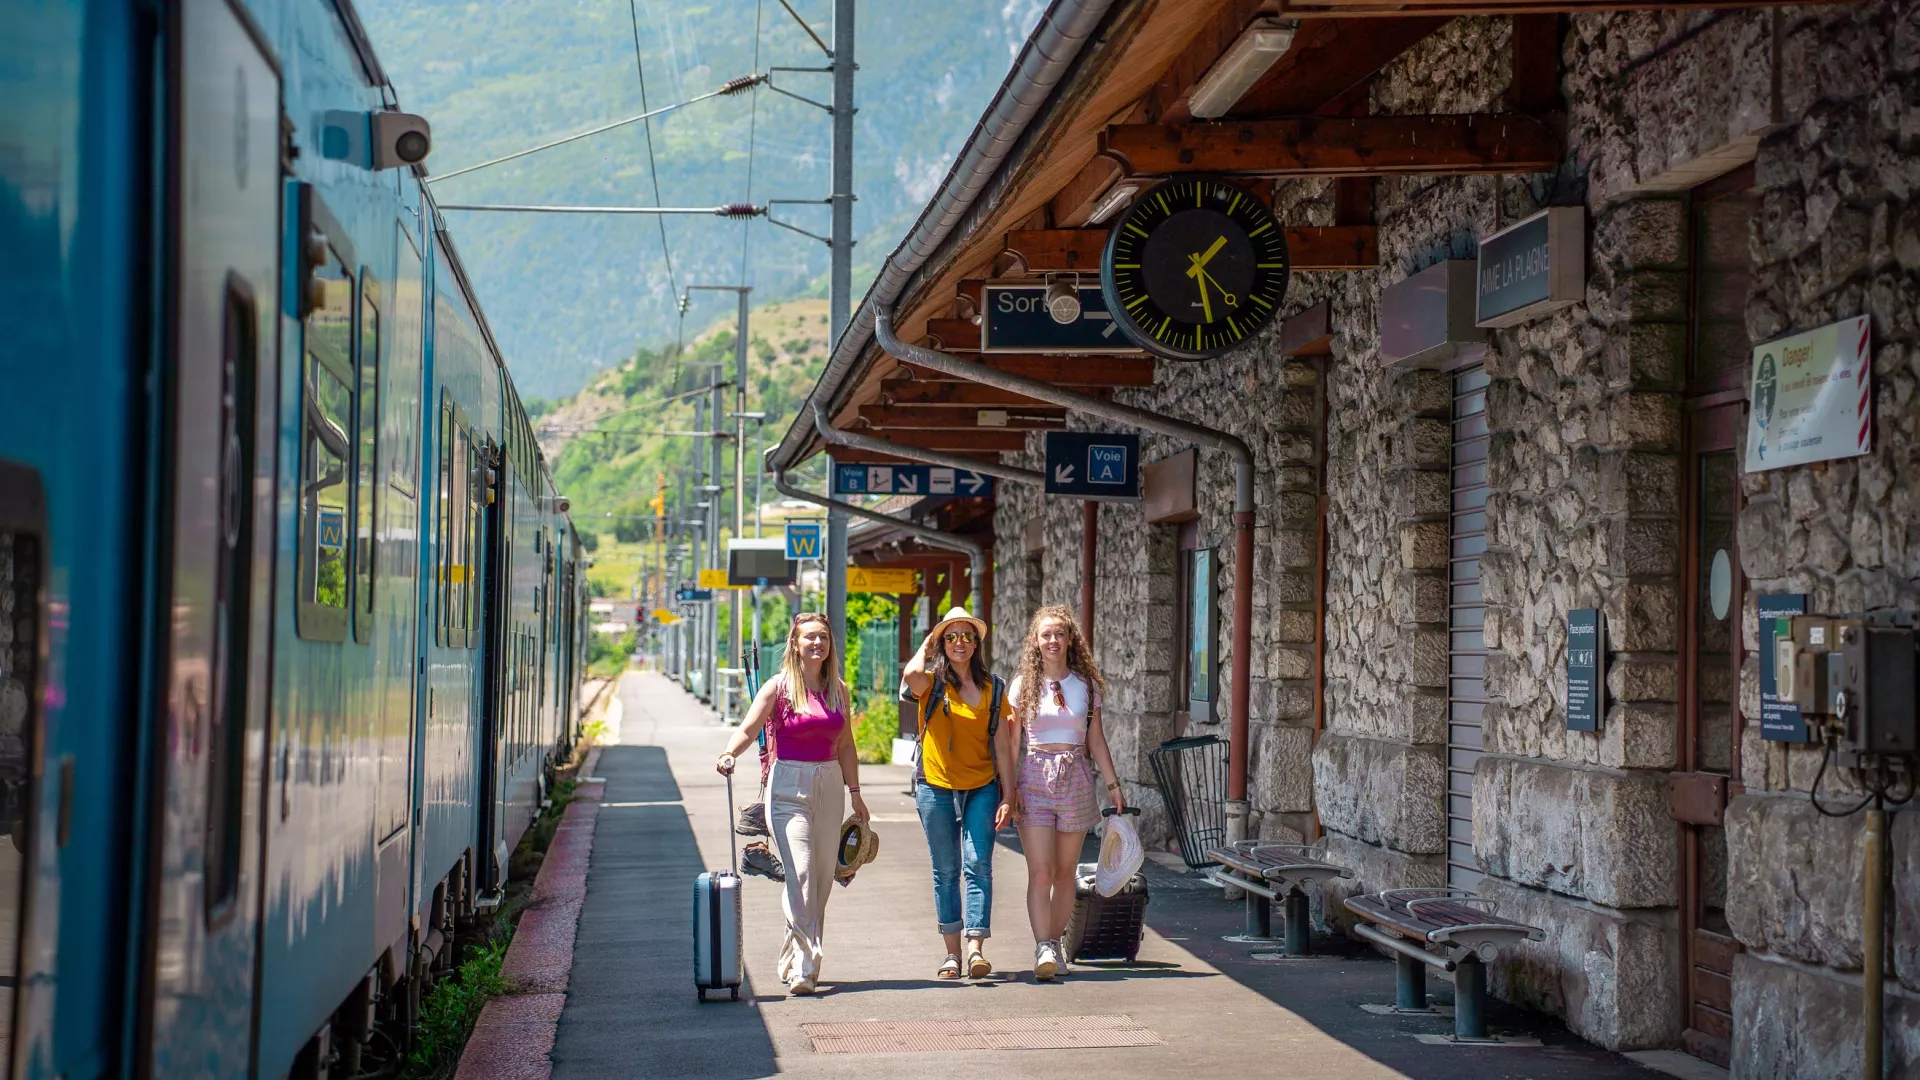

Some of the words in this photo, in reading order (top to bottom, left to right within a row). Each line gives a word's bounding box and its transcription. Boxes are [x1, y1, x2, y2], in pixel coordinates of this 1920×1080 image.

[1481, 264, 1500, 297] AIME
[1502, 257, 1513, 288] LA
[1515, 243, 1550, 283] PLAGNE
[998, 292, 1050, 313] Sort
[1094, 450, 1121, 461] Voie
[844, 468, 864, 477] Voie
[1100, 464, 1113, 479] A
[849, 479, 858, 489] B
[792, 537, 816, 556] W
